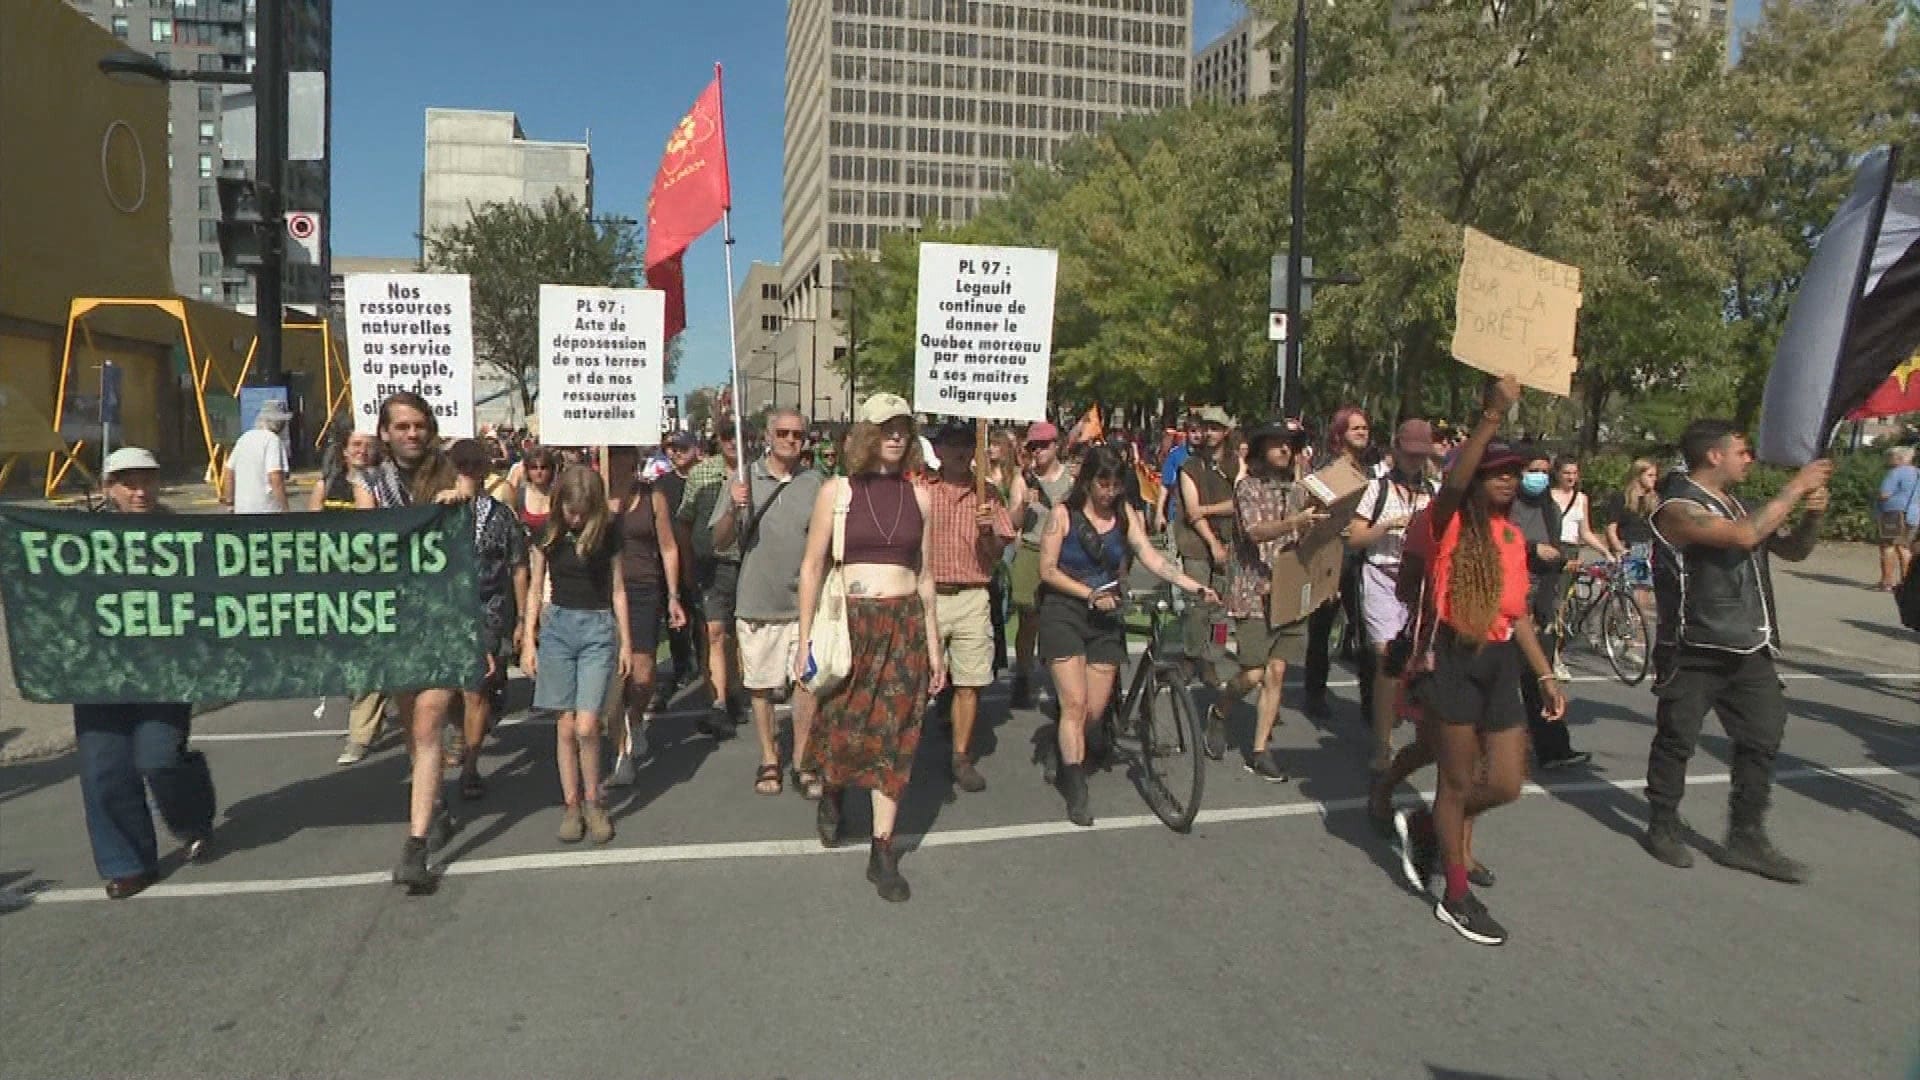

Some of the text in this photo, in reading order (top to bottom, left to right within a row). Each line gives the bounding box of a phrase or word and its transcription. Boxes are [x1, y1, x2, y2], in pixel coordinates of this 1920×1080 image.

[959, 260, 975, 275] PL
[982, 261, 1001, 275] 97
[388, 283, 421, 299] Nos
[956, 280, 1012, 297] Legault
[360, 303, 453, 314] ressources
[577, 300, 592, 313] PL
[598, 300, 616, 313] 97
[939, 298, 1026, 314] continue de
[361, 320, 452, 335] naturelles
[575, 318, 626, 332] Acte de
[945, 316, 1018, 333] donner le
[364, 340, 452, 355] au service
[552, 334, 647, 352] dépossession
[920, 333, 1042, 353] Québec morceau
[552, 352, 647, 368] de nos terres
[934, 351, 1027, 365] par morceau
[363, 359, 454, 378] du peuple,
[943, 370, 967, 381] ses
[567, 372, 633, 385] et de nos
[376, 380, 442, 398] pas des
[563, 391, 637, 402] ressources
[939, 386, 1017, 405] oligarques
[564, 406, 636, 419] naturelles
[20, 529, 447, 577] FOREST DEFENSE IS
[95, 590, 397, 639] SELF-DEFENSE
